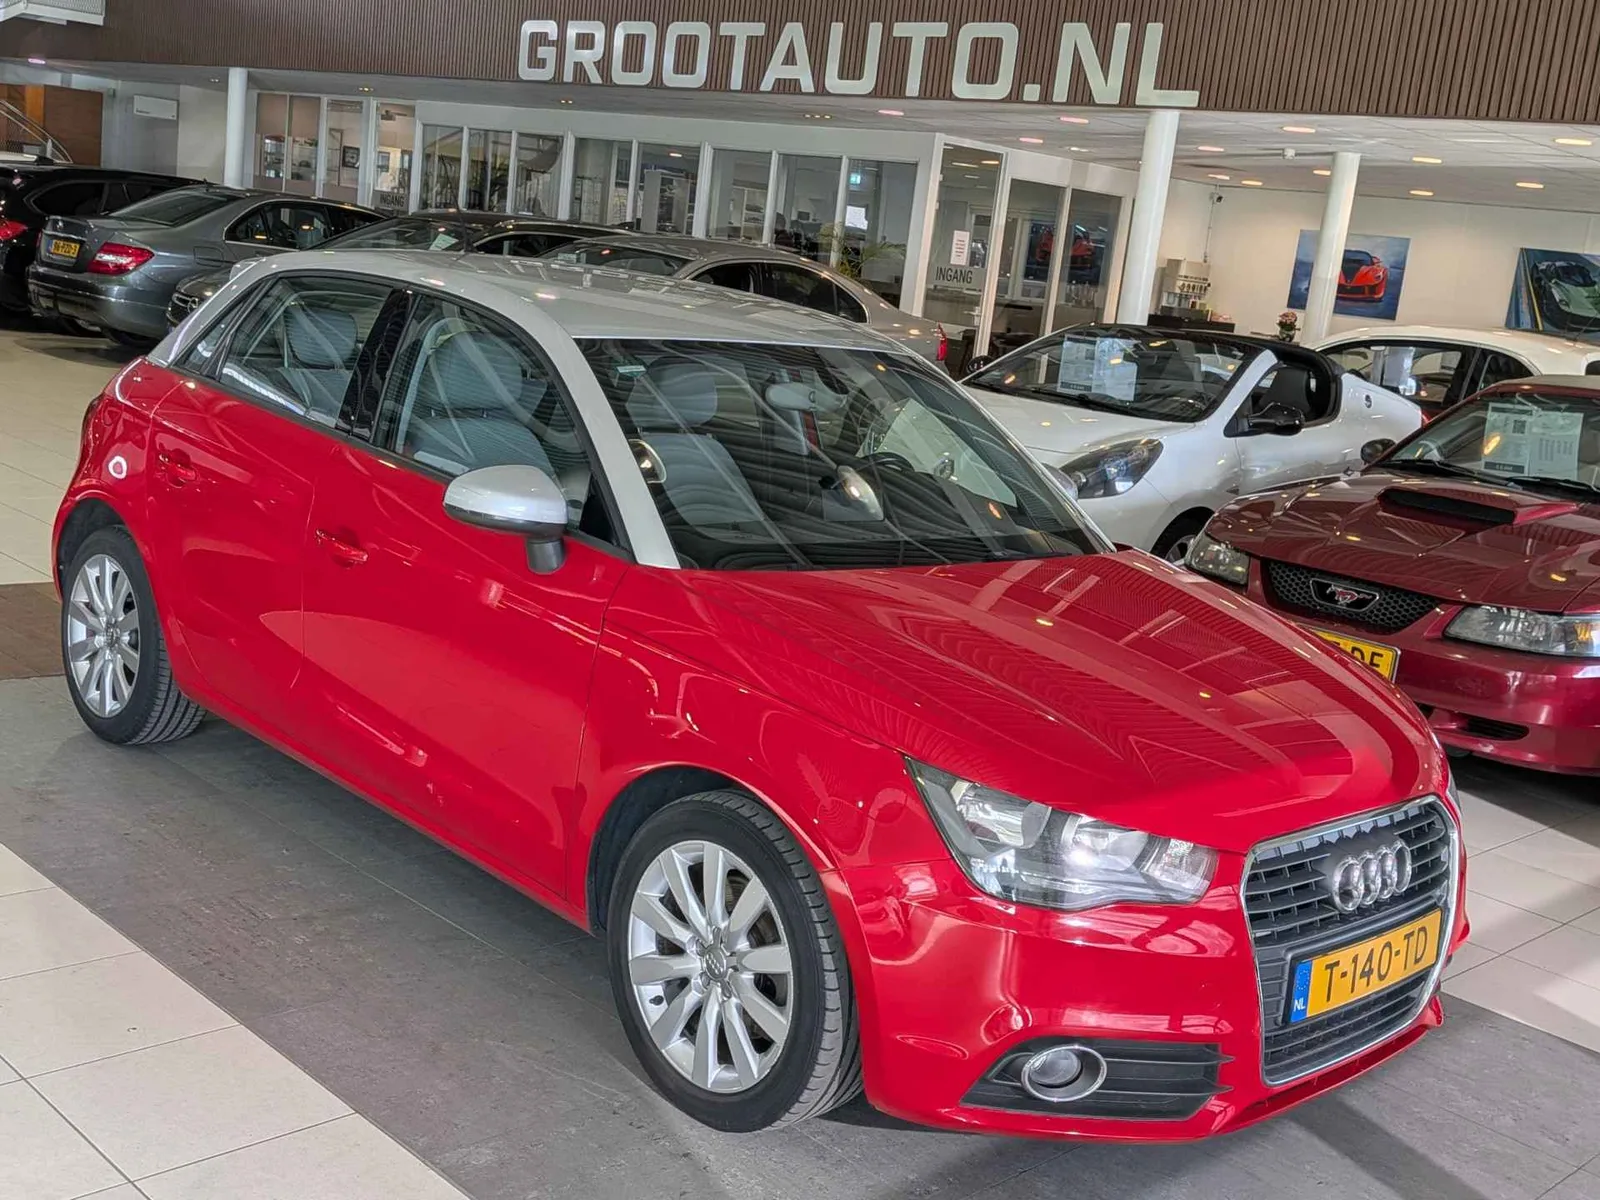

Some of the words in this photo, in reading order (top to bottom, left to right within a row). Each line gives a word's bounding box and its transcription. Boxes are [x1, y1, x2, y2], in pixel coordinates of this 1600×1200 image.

[518, 20, 1199, 108] GROOTAUTO.NL
[935, 266, 973, 284] INGANG
[1293, 998, 1306, 1012] NL
[1325, 926, 1428, 1002] T-140-TD
